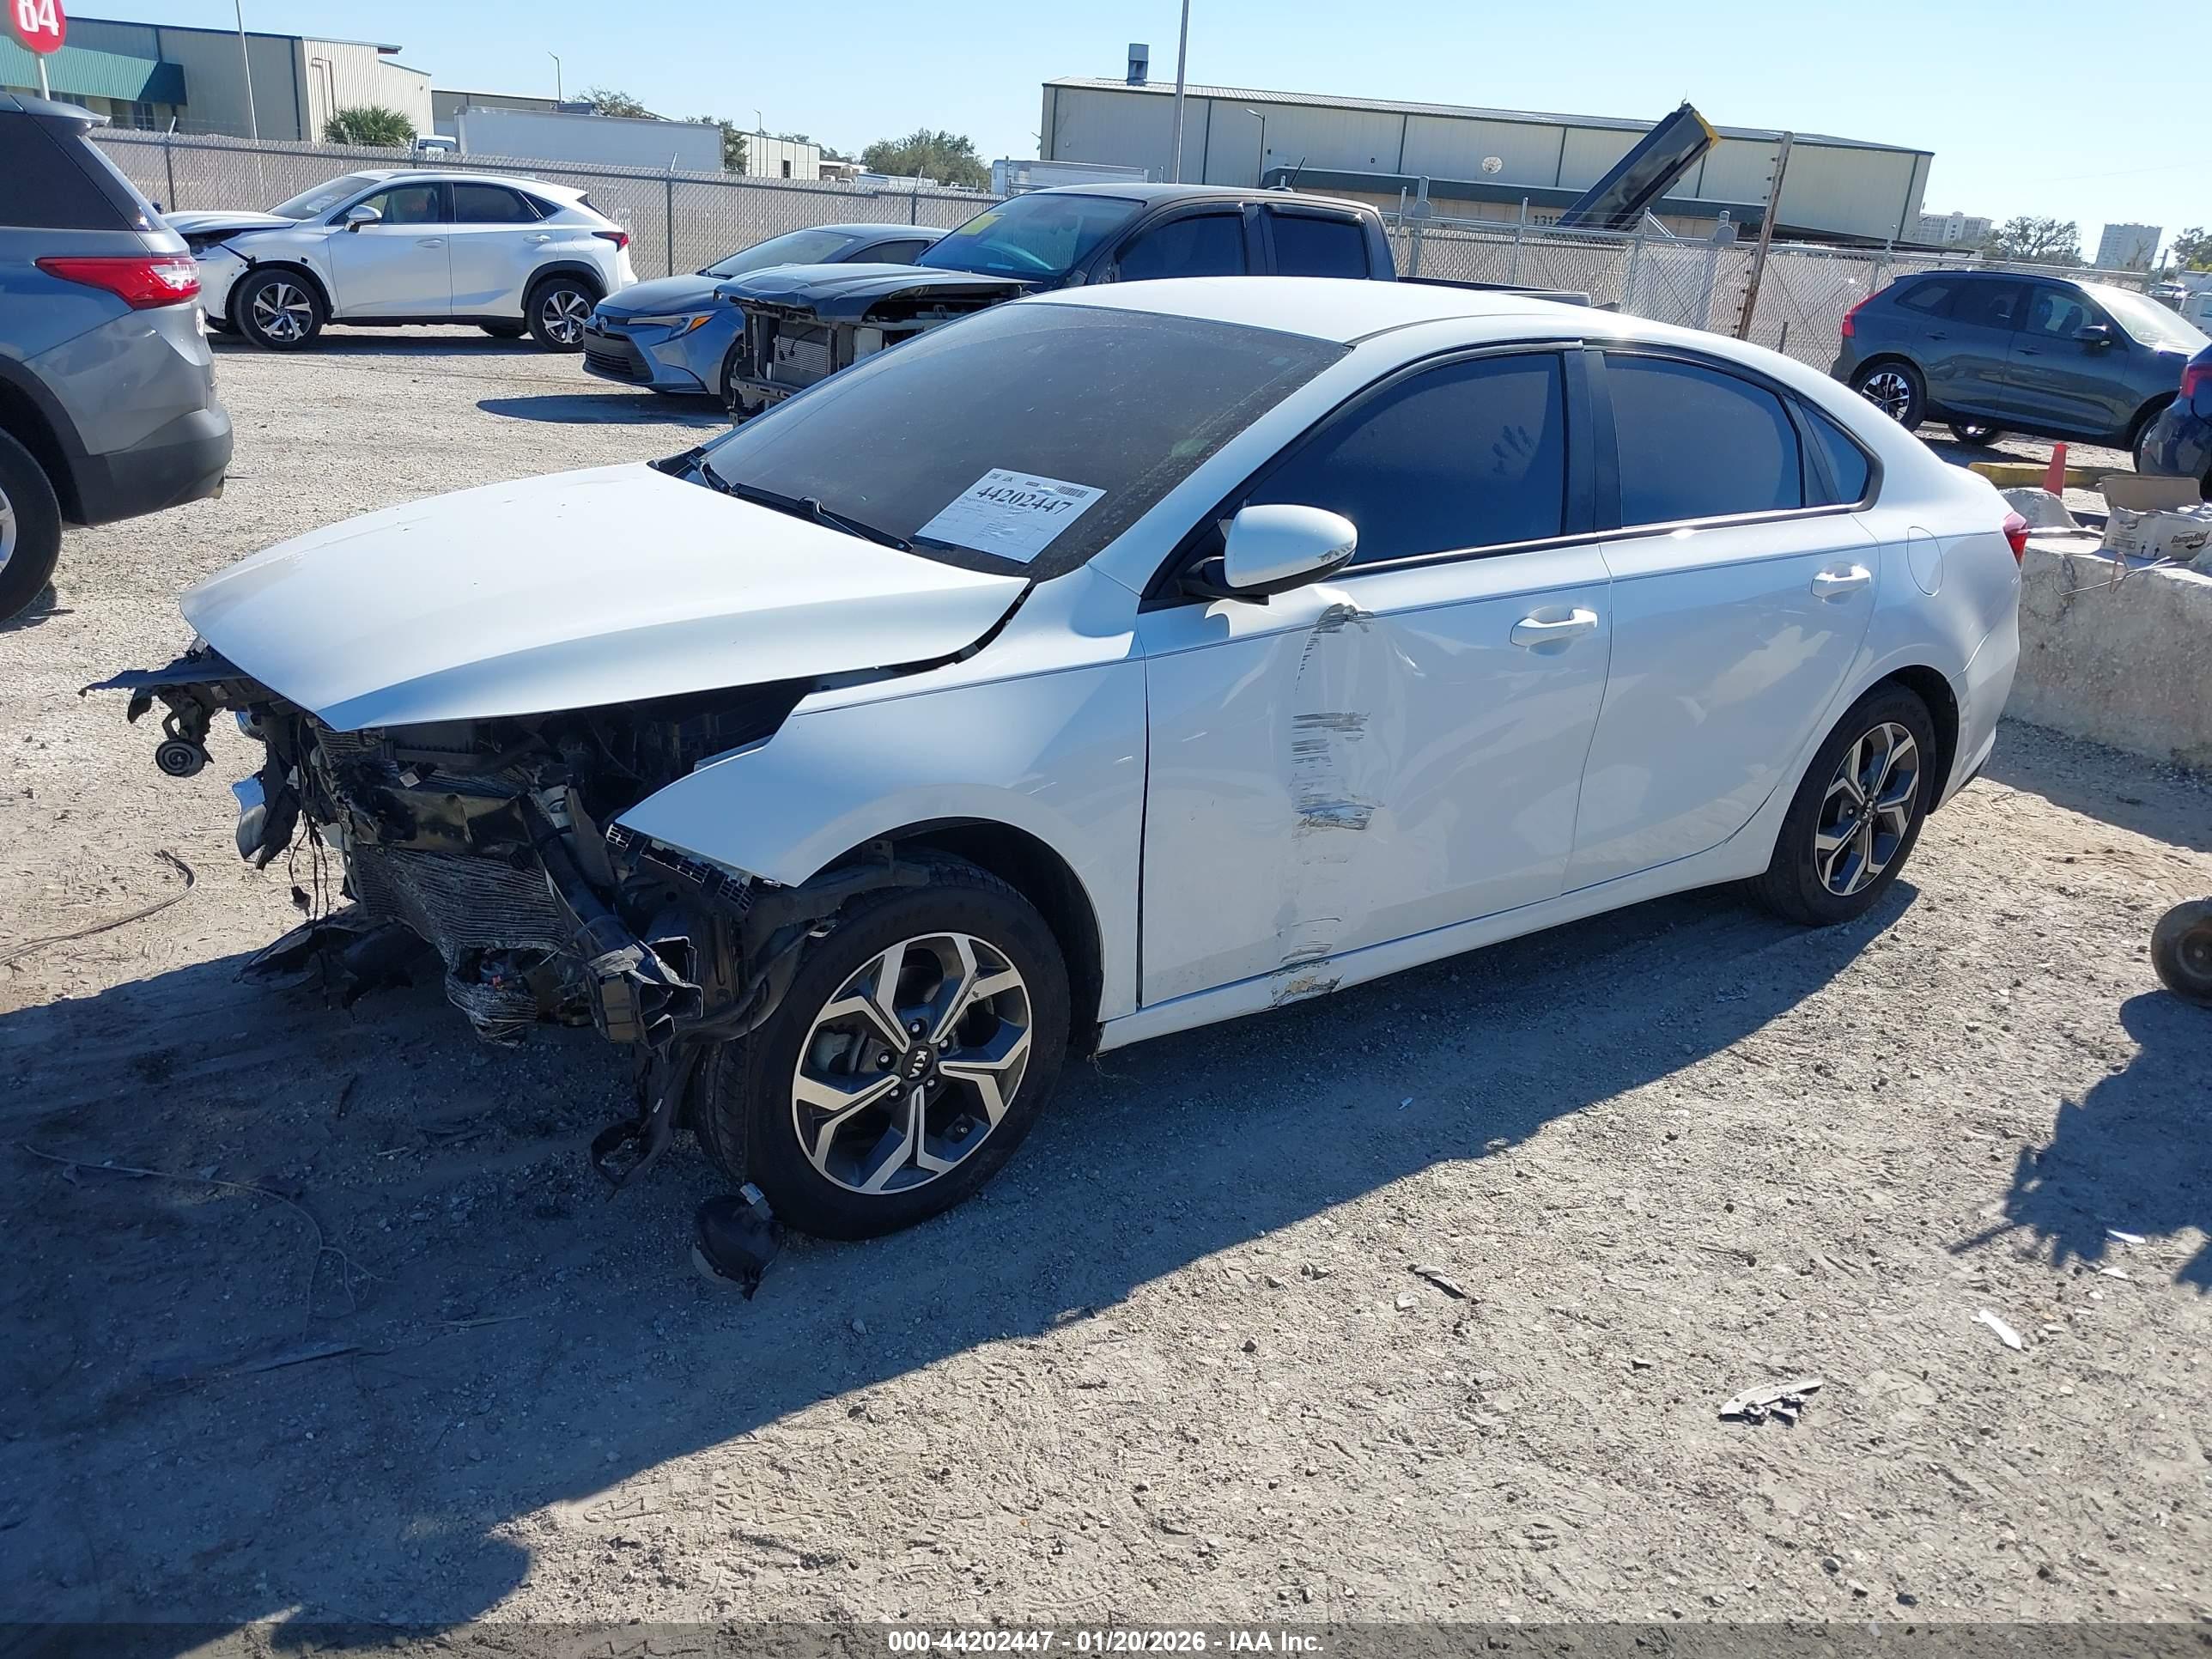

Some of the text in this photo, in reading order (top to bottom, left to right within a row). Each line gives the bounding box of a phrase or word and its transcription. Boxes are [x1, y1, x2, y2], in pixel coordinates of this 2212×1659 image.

[17, 0, 59, 36] 84
[976, 485, 1074, 515] 44202447
[908, 1050, 927, 1078] KIA
